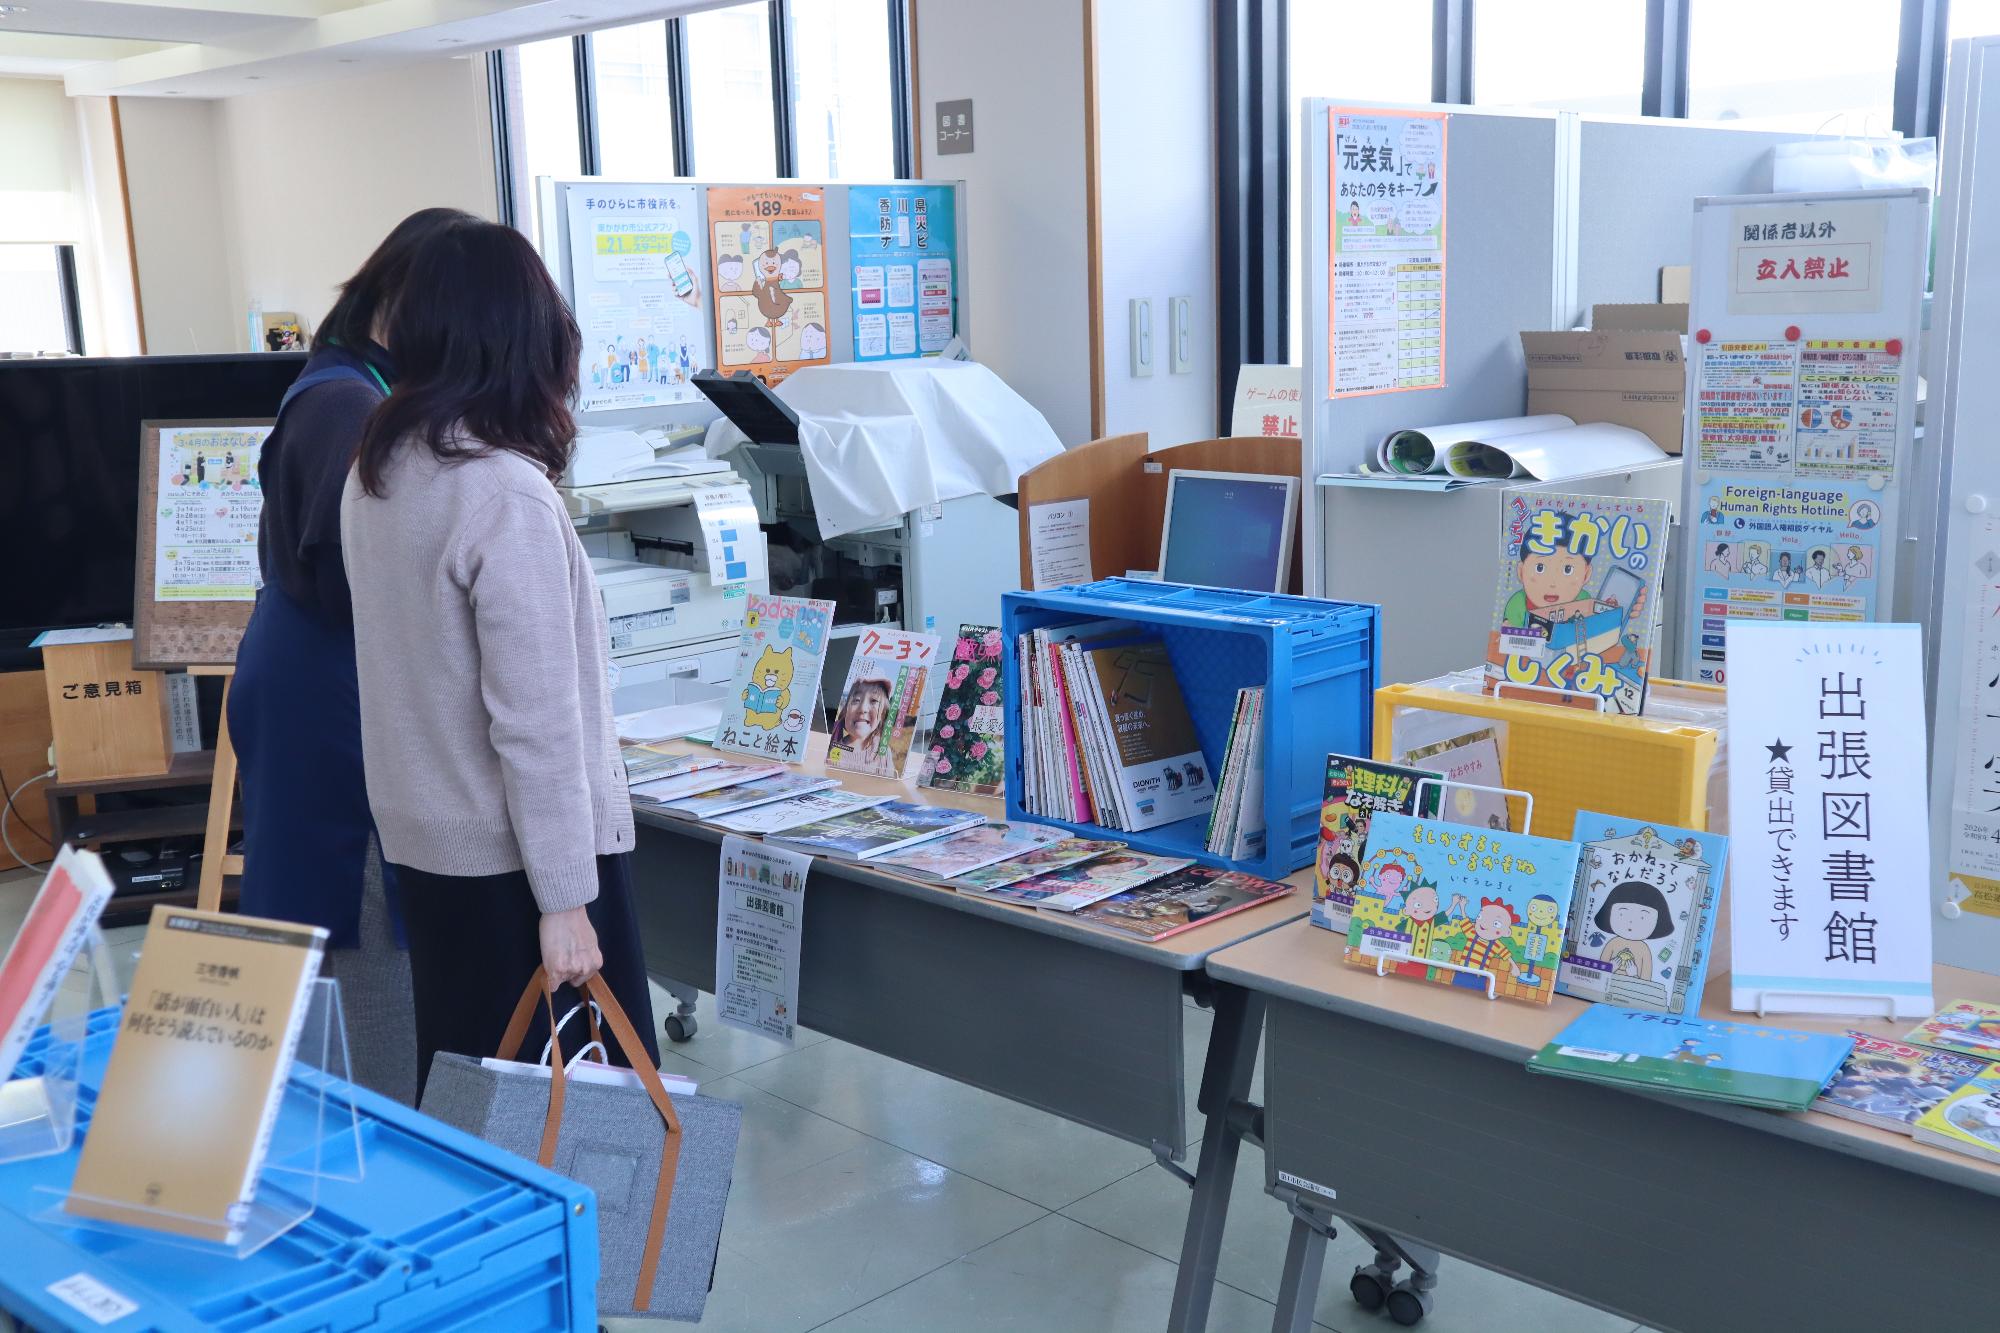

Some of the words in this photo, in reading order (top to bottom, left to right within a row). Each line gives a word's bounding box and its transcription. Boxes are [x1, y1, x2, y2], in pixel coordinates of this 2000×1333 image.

[940, 129, 969, 141] コーナー
[1340, 182, 1422, 197] あなたの今をキープ
[586, 198, 680, 211] 手のひらに市役所を。
[753, 201, 782, 217] 189
[880, 197, 927, 214] 香川県
[1743, 220, 1837, 241] 関係者以外
[1755, 256, 1850, 281] 立入禁止
[1247, 388, 1302, 402] ゲームの使
[1262, 414, 1298, 437] 禁止
[1535, 498, 1645, 514] ぼくだけがしっている
[1726, 486, 1844, 504] Foreign-language
[1720, 501, 1758, 513] Human
[1762, 502, 1798, 516] Rights
[1507, 496, 1532, 557] ヘンテコな
[1748, 522, 1834, 534] 外国語人権相談ダイヤル
[1528, 508, 1651, 571] きかいの
[862, 630, 932, 661] クーヨン
[1504, 652, 1625, 699] しくみ
[63, 680, 143, 700] ご意見箱
[1623, 687, 1636, 700] 12
[721, 728, 799, 757] ねこと絵本
[1344, 789, 1405, 814] なぞ解き
[1816, 671, 1879, 965] 出張図書館
[1412, 824, 1501, 854] もしかすると
[1446, 852, 1538, 876] いるかもね
[1613, 851, 1679, 876] おかねって
[1607, 867, 1680, 894] なんだろう
[148, 990, 266, 1026] 「話が面白い人」は
[1622, 1012, 1703, 1028] イチロー
[126, 1013, 274, 1051] 何をどう読んでいるのか
